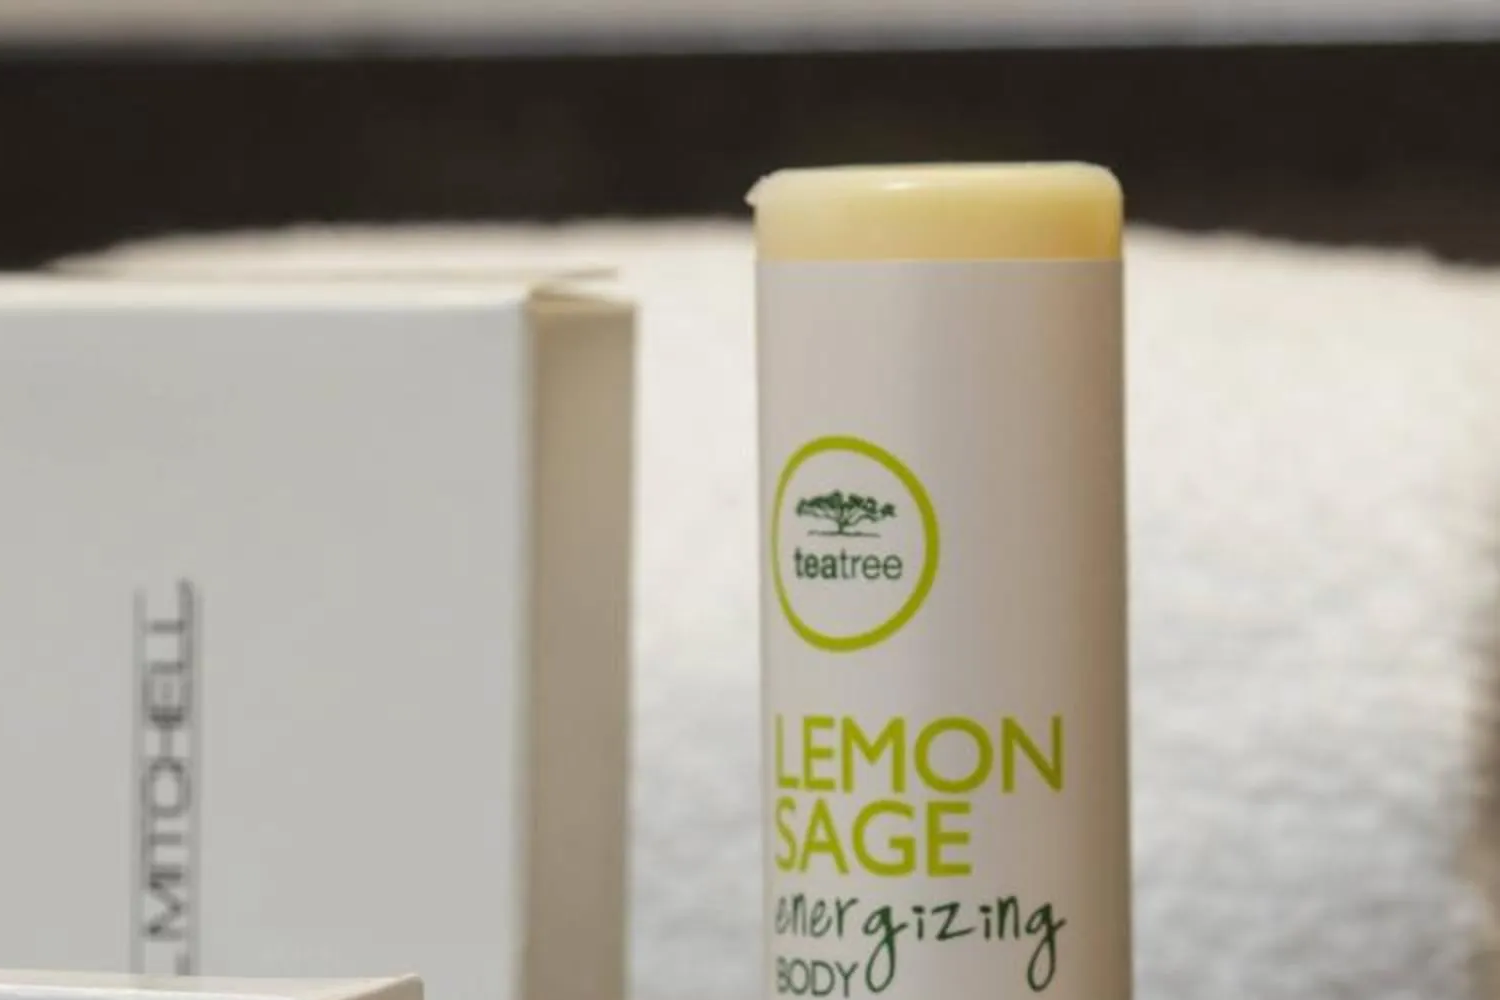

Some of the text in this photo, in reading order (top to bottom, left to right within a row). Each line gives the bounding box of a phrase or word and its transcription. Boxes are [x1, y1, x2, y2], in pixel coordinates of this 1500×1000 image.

[141, 578, 194, 942] MITCHELL
[776, 714, 1063, 794] LEMON
[775, 796, 973, 878] SAGE
[775, 893, 1067, 993] energizing
[776, 956, 859, 997] BODY
